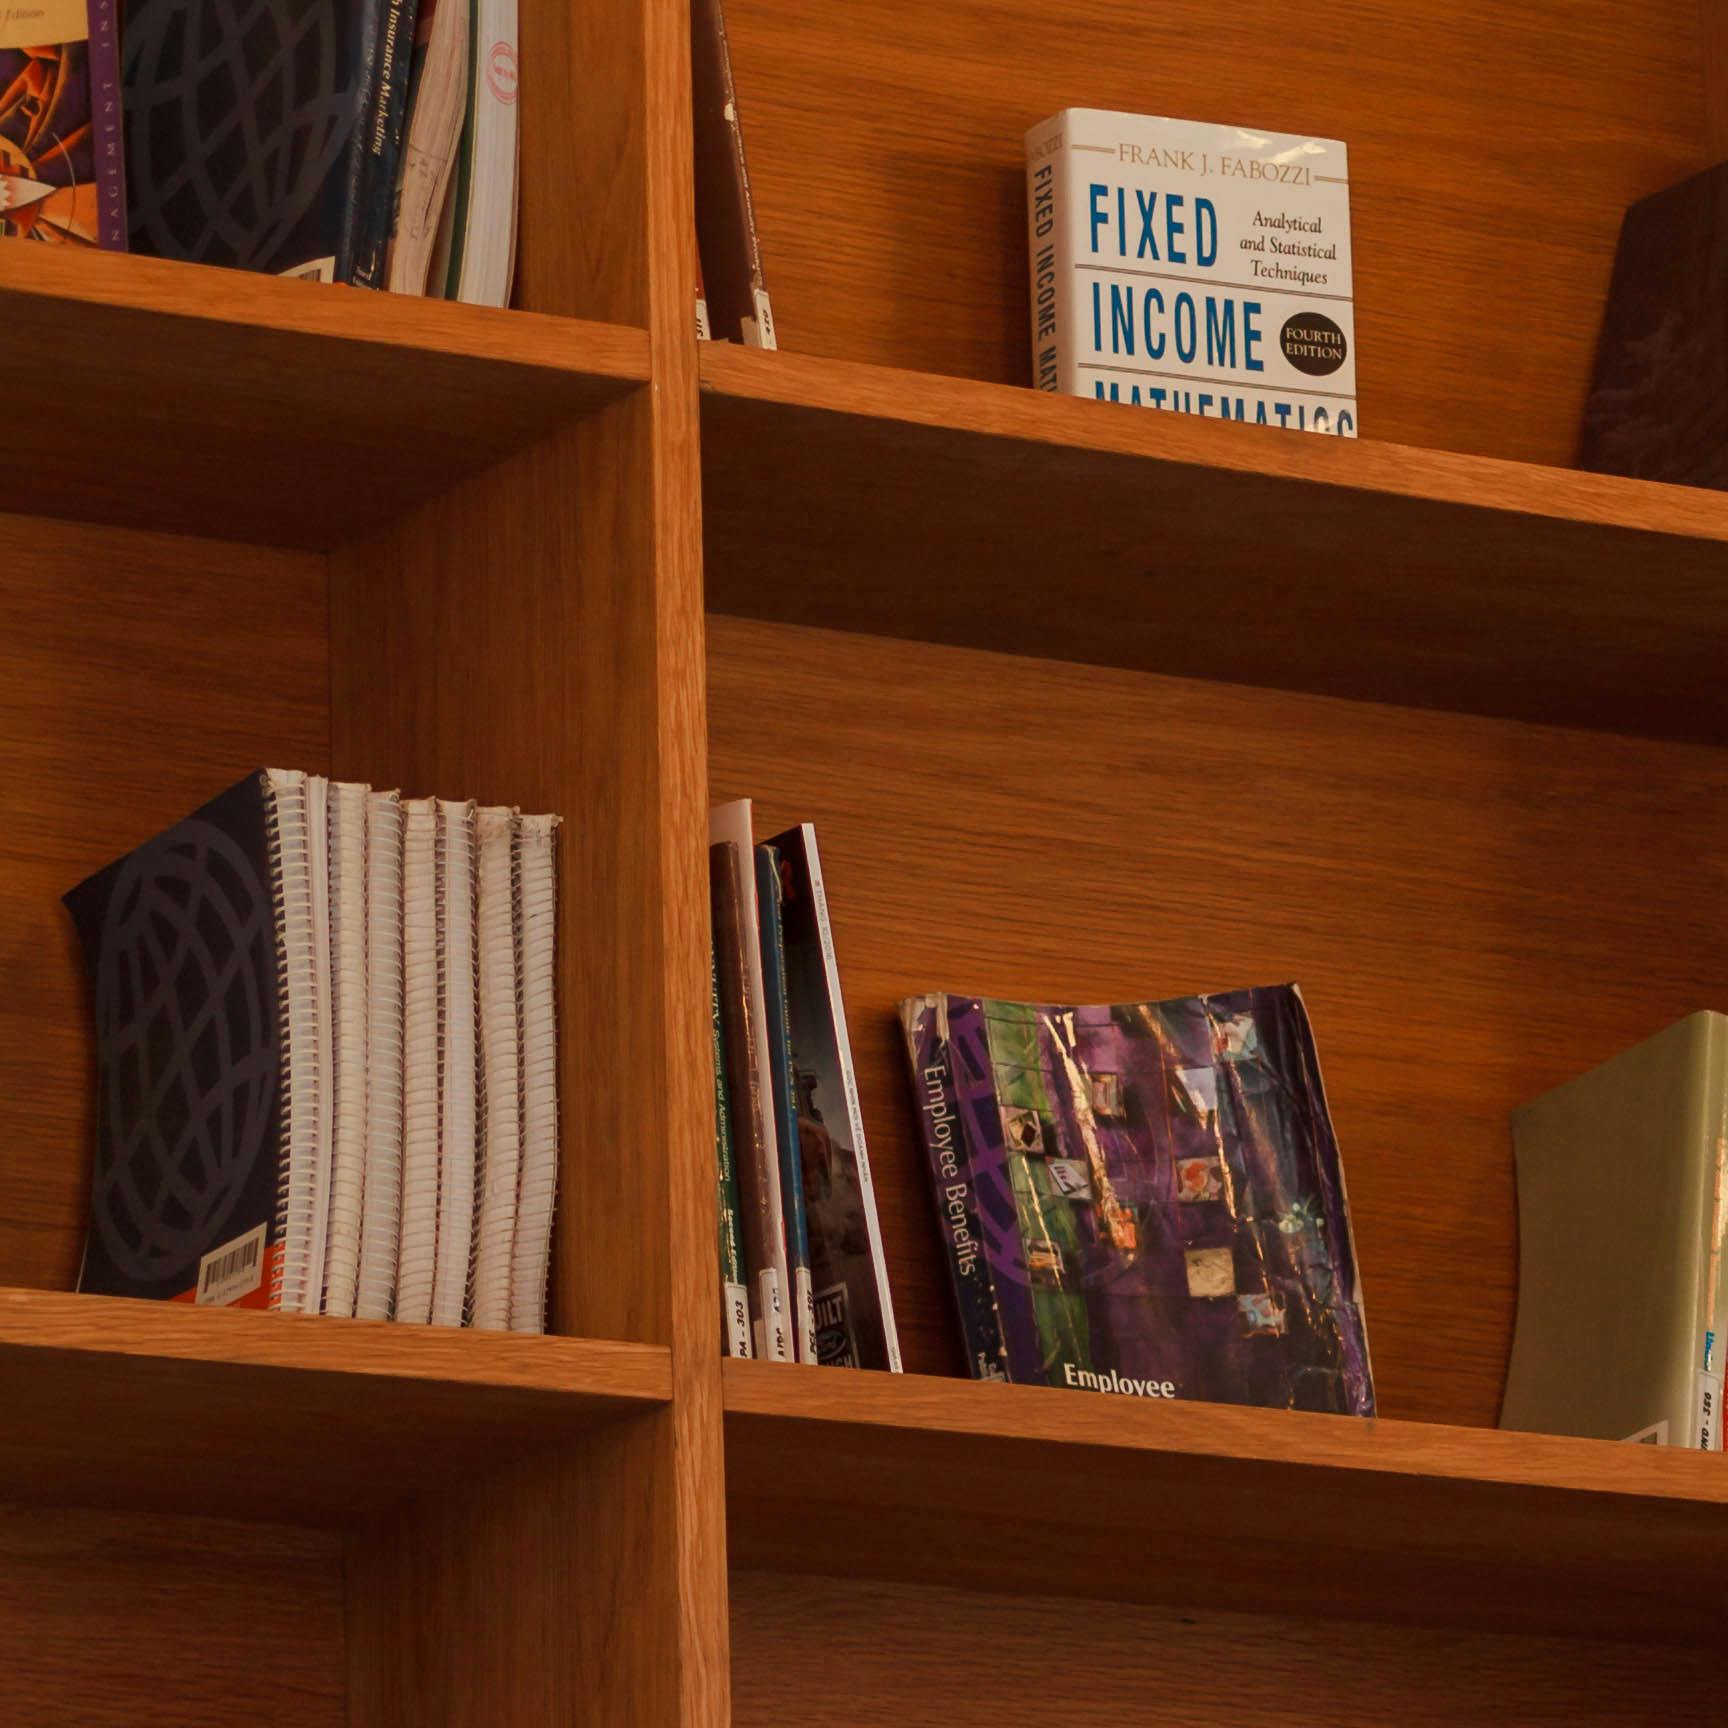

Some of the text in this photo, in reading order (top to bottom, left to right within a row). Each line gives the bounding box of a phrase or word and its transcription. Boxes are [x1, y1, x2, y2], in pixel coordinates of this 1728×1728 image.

[383, 6, 401, 77] Insurance
[371, 77, 392, 157] Marketing
[1118, 143, 1312, 187] FRANK J. FABOZZI
[1089, 183, 1218, 268] FIXED
[1251, 211, 1323, 235] Analytical
[1034, 163, 1056, 341] FIXED INCOME
[1239, 236, 1337, 261] and Statistical
[1250, 260, 1328, 286] Techniques
[1092, 282, 1265, 372] INCOME
[1285, 327, 1342, 345] FOURTH
[1285, 343, 1343, 361] EDITION
[922, 1064, 977, 1277] Employee Benefits
[1063, 1362, 1175, 1398] Employee
